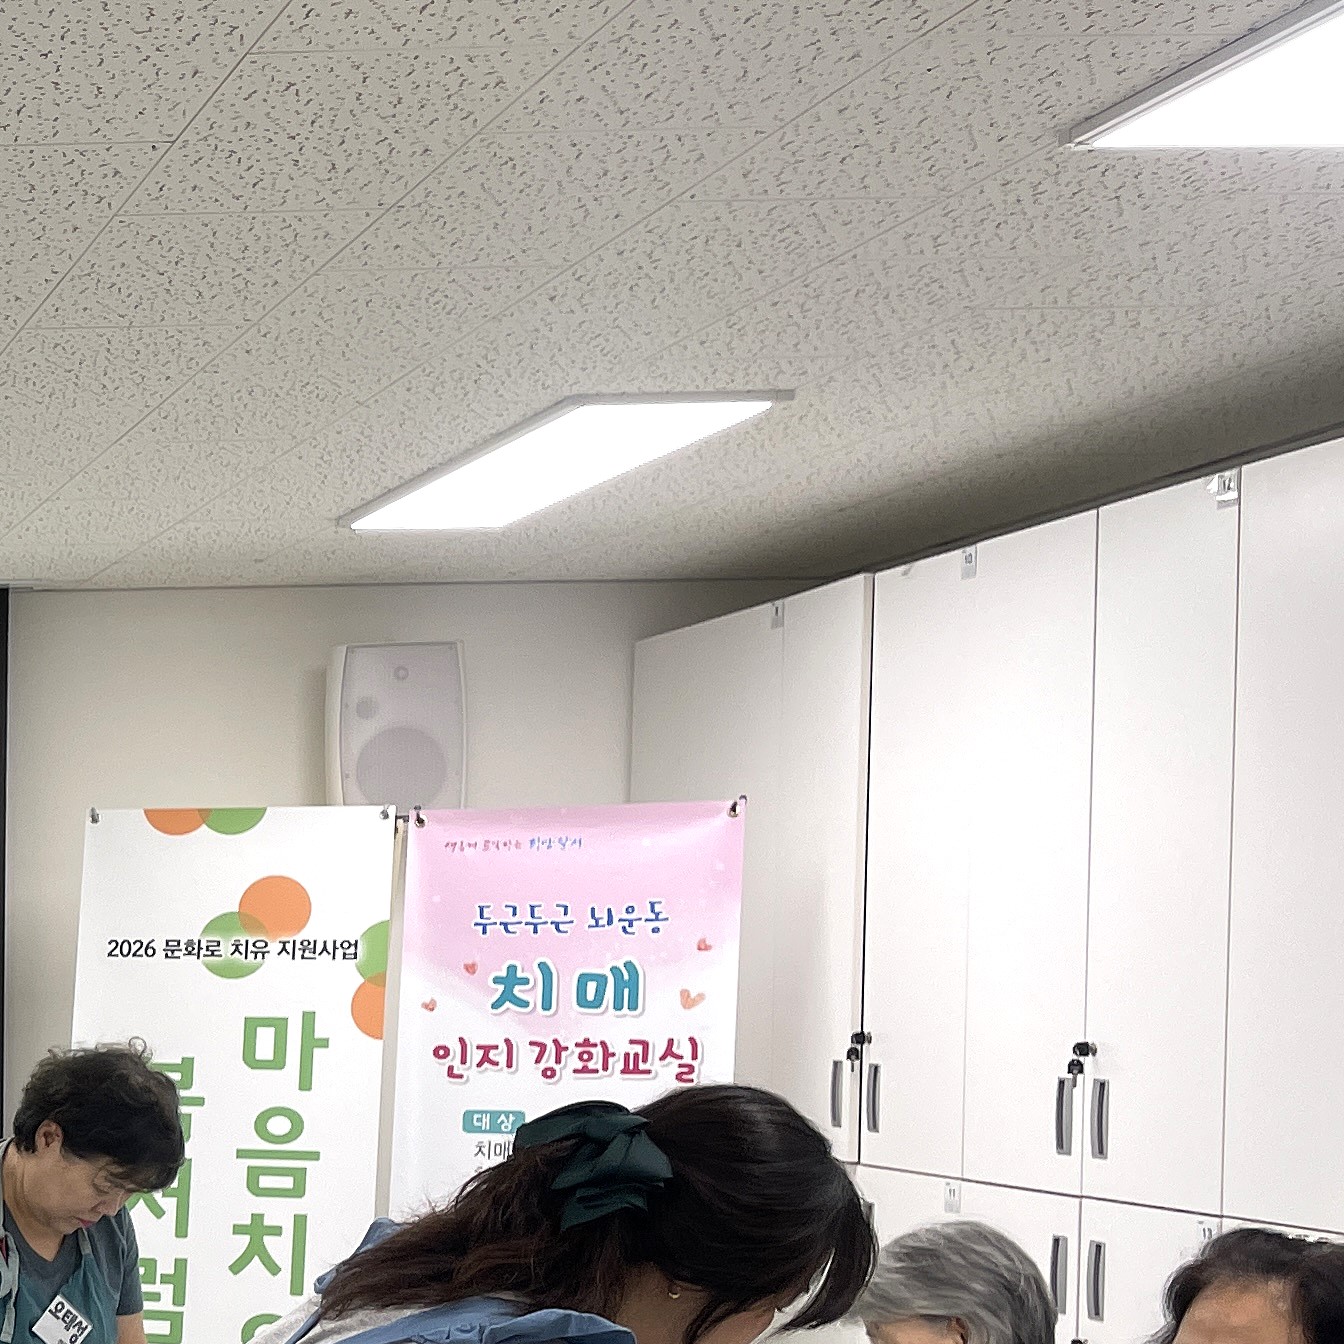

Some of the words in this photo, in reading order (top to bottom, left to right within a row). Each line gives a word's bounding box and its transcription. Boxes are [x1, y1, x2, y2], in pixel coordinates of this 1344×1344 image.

[473, 904, 575, 935] 두근두근
[587, 900, 670, 935] 뇌운동
[107, 939, 157, 959] 2026
[163, 939, 223, 961] 문화로
[230, 939, 271, 961] 치유
[277, 939, 360, 961] 지원사업
[432, 1037, 514, 1080] 인지
[528, 1036, 700, 1084] 강화교실
